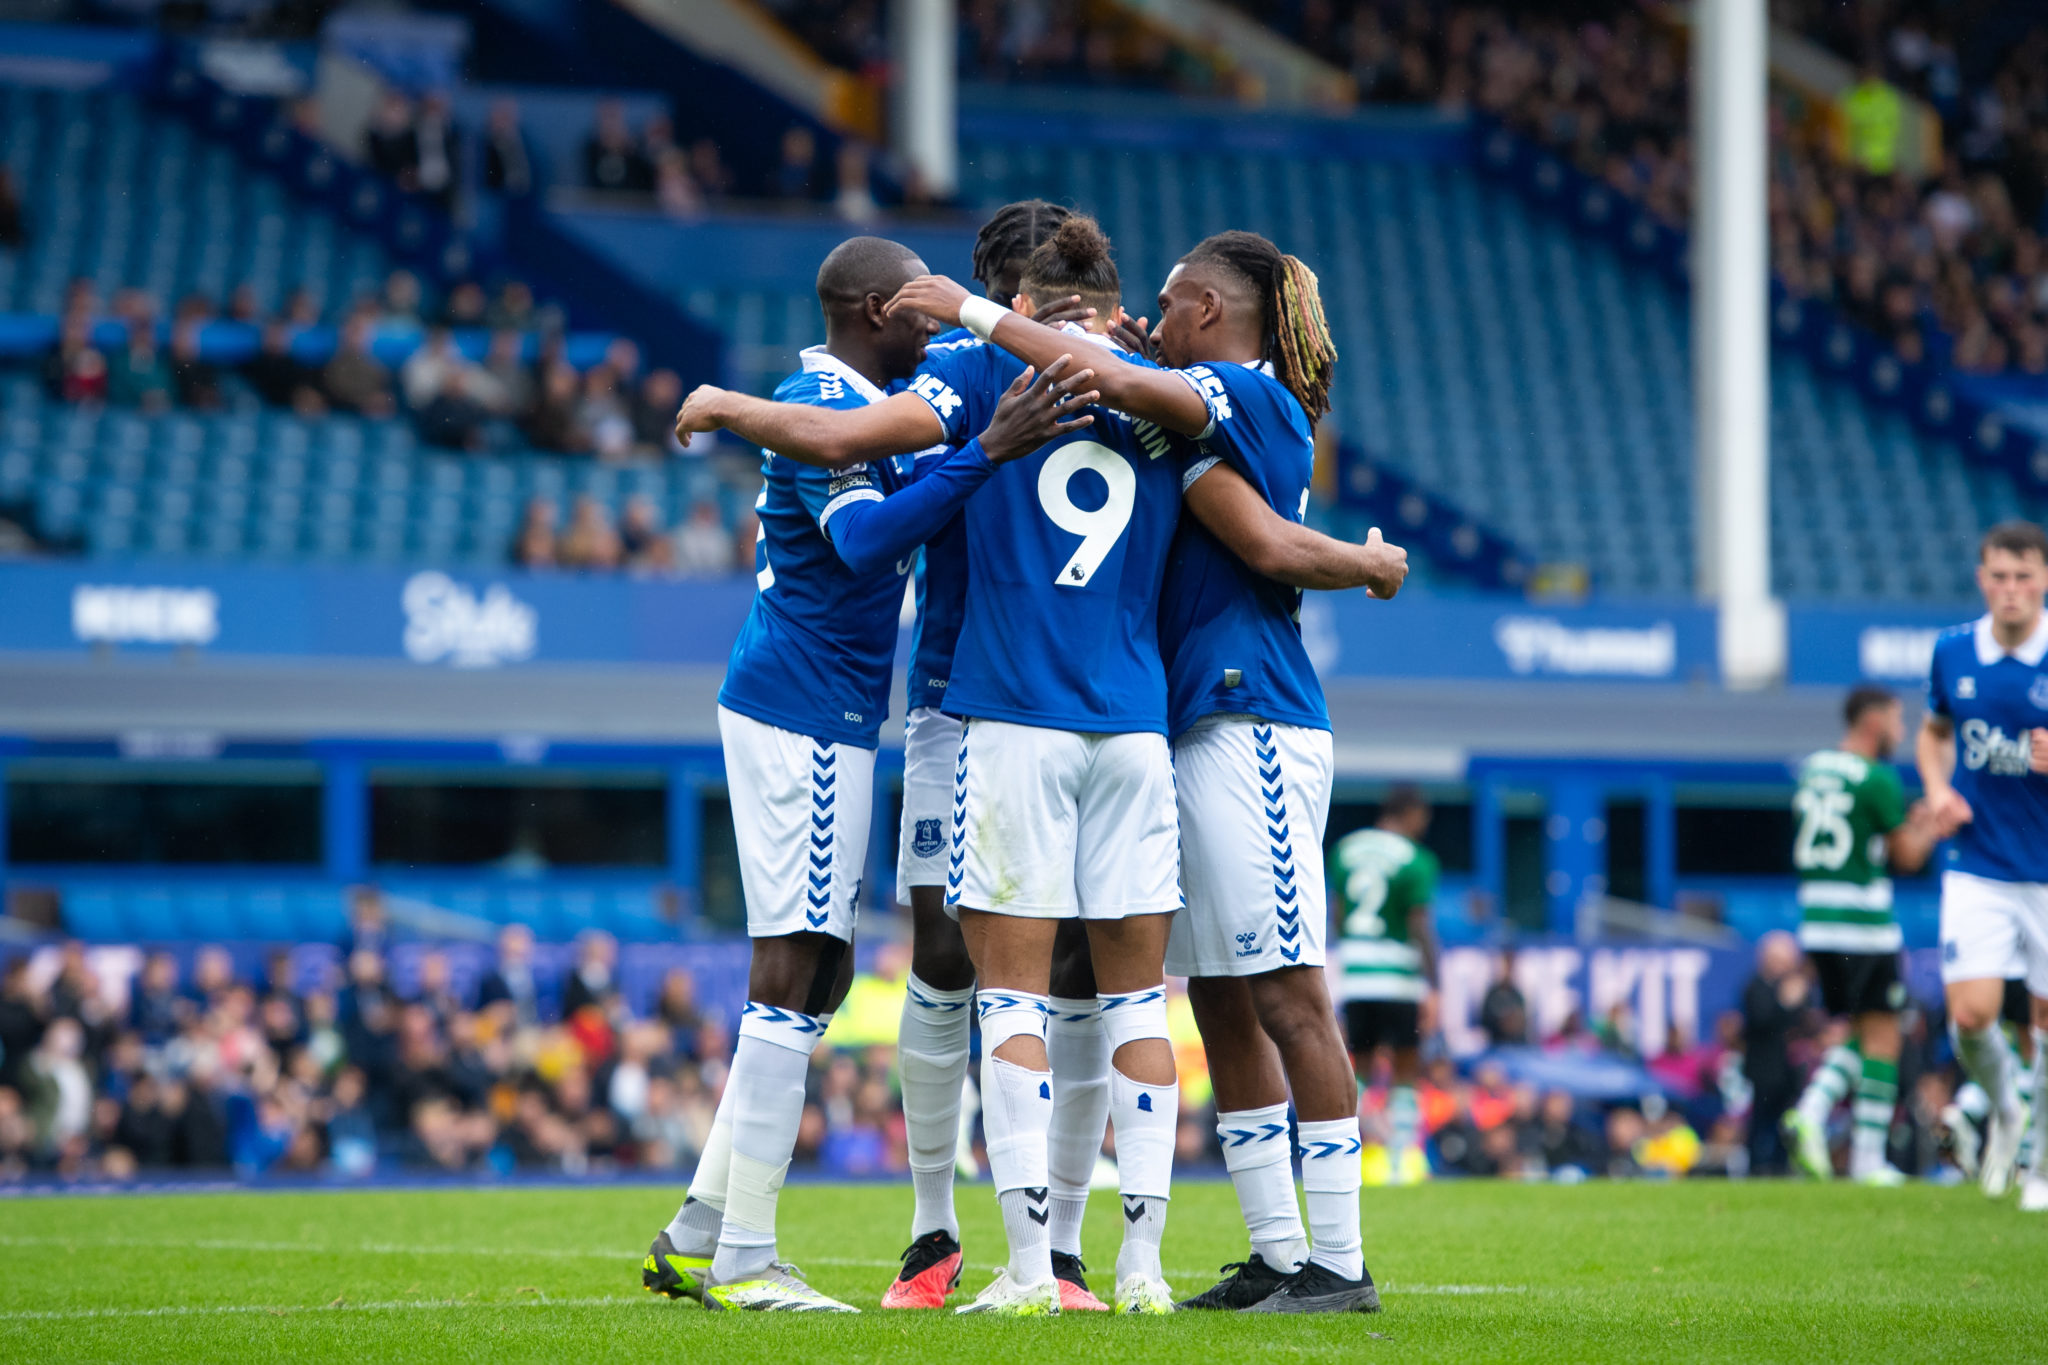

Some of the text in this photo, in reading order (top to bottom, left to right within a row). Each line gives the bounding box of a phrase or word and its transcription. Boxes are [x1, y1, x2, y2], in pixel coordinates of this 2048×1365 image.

[1037, 440, 1136, 587] 9
[1793, 789, 1855, 872] 25
[1345, 864, 1388, 936] 2
